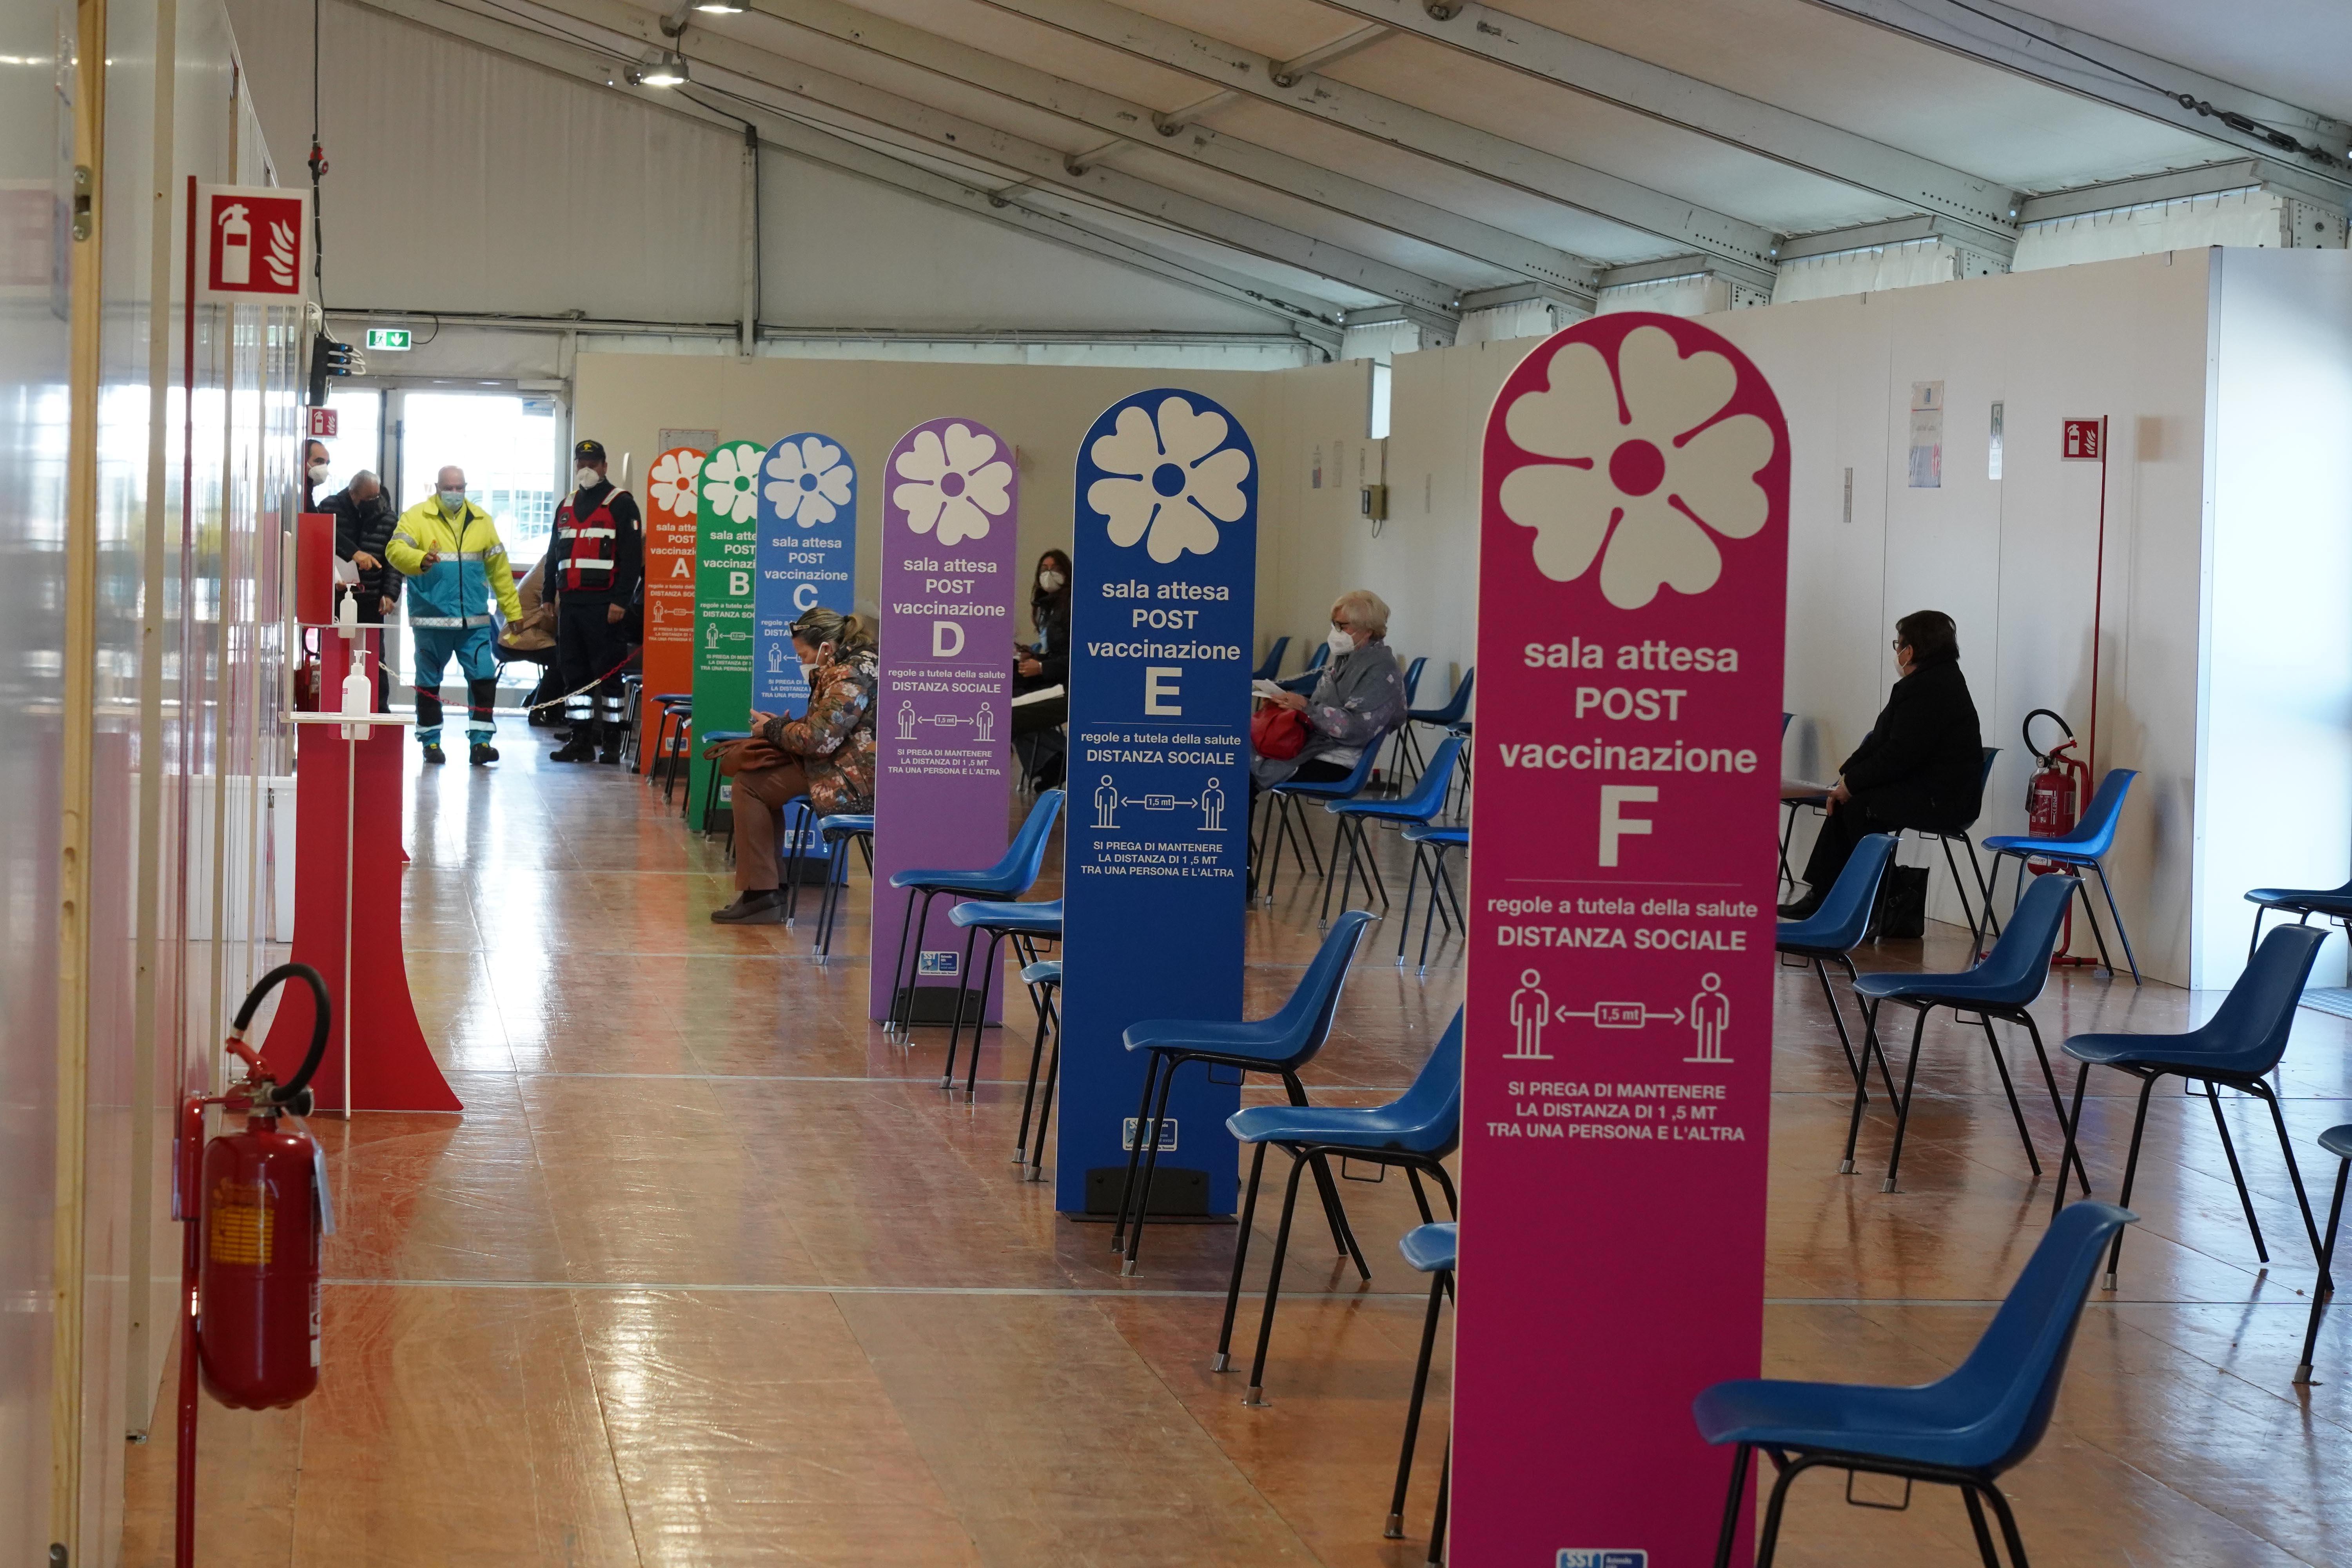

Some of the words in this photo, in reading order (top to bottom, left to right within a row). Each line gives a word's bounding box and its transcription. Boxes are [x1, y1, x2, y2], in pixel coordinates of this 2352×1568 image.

[656, 523, 675, 531] sala
[668, 535, 696, 543] POST
[710, 531, 733, 540] sala
[737, 532, 756, 540] atte
[773, 537, 798, 547] sala
[802, 537, 841, 548] attesa
[651, 547, 695, 555] vaccinazi
[725, 544, 756, 554] POST
[703, 559, 756, 568] vaccinazi
[789, 553, 825, 563] POST
[904, 557, 938, 571] sala
[944, 559, 996, 573] attesa
[671, 557, 690, 578] A
[765, 569, 848, 580] vaccinazione
[730, 572, 750, 595] B
[926, 579, 975, 593] POST
[1102, 580, 1149, 598] sala
[1157, 582, 1229, 600] attesa
[793, 584, 818, 611] C
[893, 601, 1005, 616] vaccinazione
[1133, 609, 1198, 629] POST
[933, 621, 964, 657] D
[1088, 639, 1240, 660] vaccinazione
[1524, 637, 1603, 668] sala
[1617, 640, 1738, 672] attesa
[889, 669, 916, 677] regole
[893, 682, 949, 691] DISTANZA
[952, 683, 1001, 693] SOCIALE
[1145, 667, 1182, 715] E
[1576, 687, 1687, 720] POST
[1082, 732, 1119, 744] regole
[1134, 733, 1168, 743] tutela
[1172, 734, 1200, 744] della
[1205, 735, 1241, 745] salute
[1087, 750, 1163, 762] DISTANZA
[1168, 751, 1234, 764] SOCIALE
[1499, 738, 1757, 773] vaccinazione
[1599, 785, 1659, 867] F
[1107, 842, 1142, 850] PREGA
[1158, 843, 1222, 852] MANTENERE
[1115, 854, 1165, 863] DISTANZA
[1130, 867, 1179, 875] PERSONA
[1192, 868, 1234, 877] L'ALTRA
[1488, 896, 1552, 916] regole
[1559, 900, 1570, 913] a
[1577, 898, 1635, 915] tutela
[1641, 899, 1690, 916] della
[1696, 900, 1758, 917] salute
[1498, 926, 1627, 948] DISTANZA
[1634, 929, 1746, 951] SOCIALE
[1602, 1008, 1620, 1021] 1,5
[1623, 1009, 1639, 1020] mt
[1508, 1081, 1524, 1095] SI
[1530, 1082, 1590, 1096] PREGA
[1595, 1083, 1612, 1097] DI
[1617, 1084, 1726, 1099] MANTENERE
[1517, 1103, 1538, 1116] LA
[1543, 1103, 1630, 1118] DISTANZA
[1635, 1105, 1652, 1118] DI
[1691, 1106, 1717, 1119] MT
[1487, 1123, 1521, 1137] TRA
[1527, 1123, 1563, 1137] UNA
[1569, 1124, 1652, 1139] PERSONA
[1658, 1126, 1668, 1139] E
[1674, 1126, 1744, 1141] L'ALTRA
